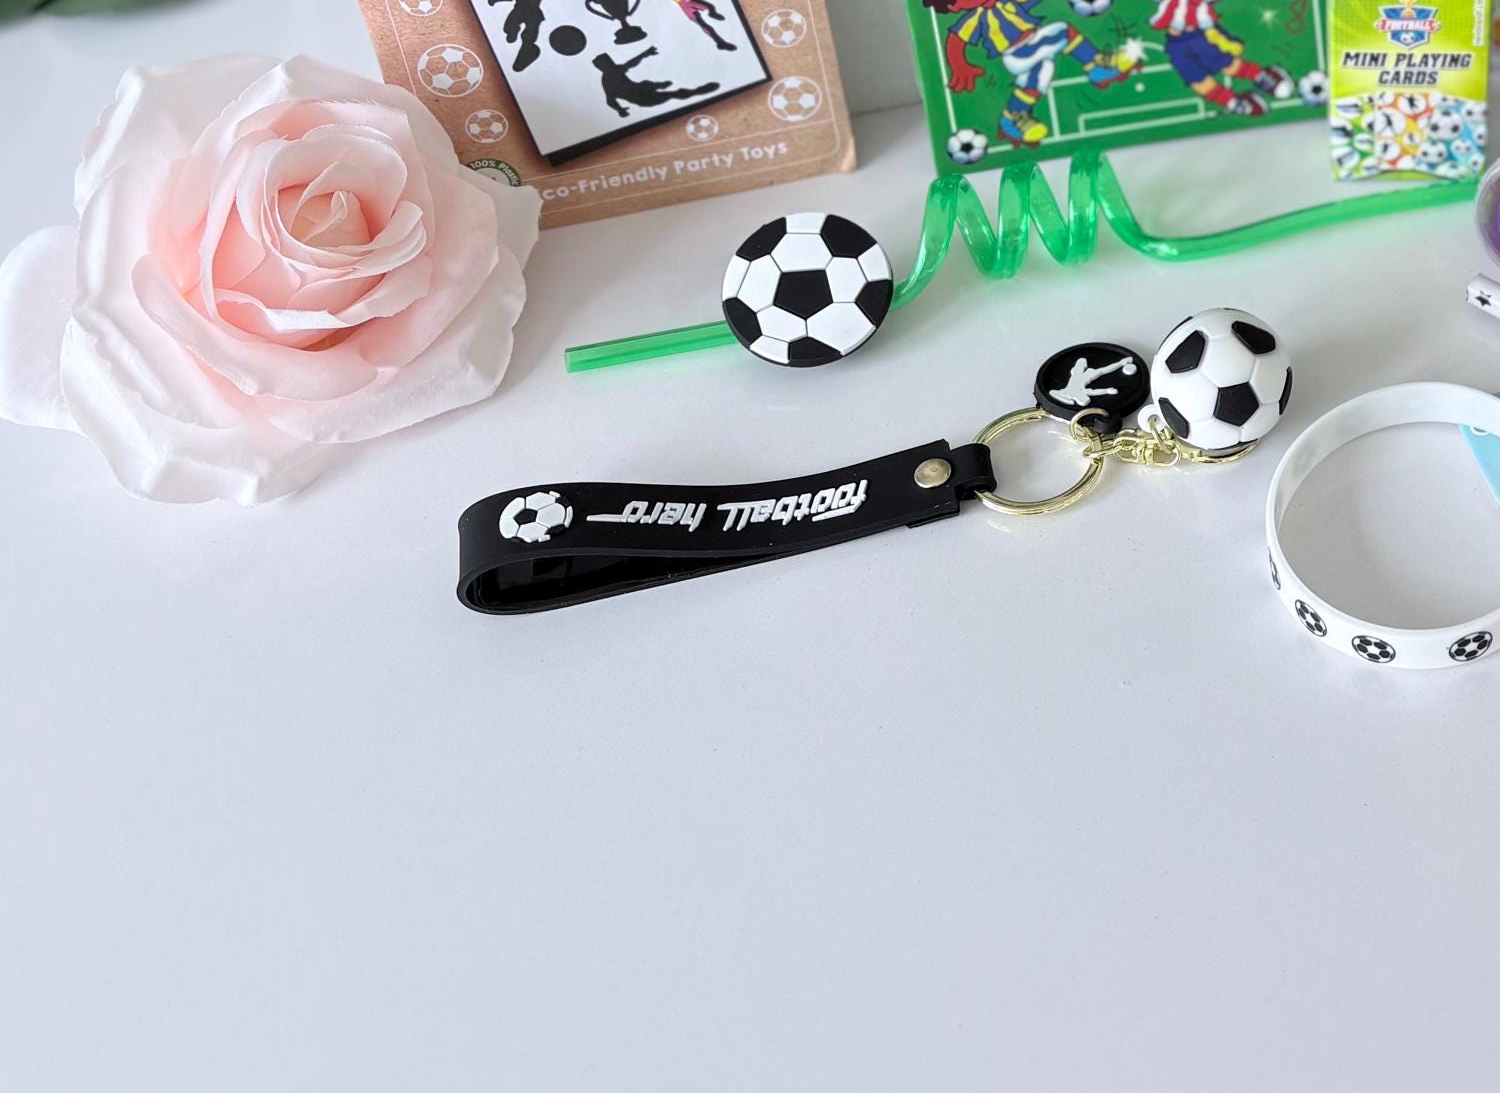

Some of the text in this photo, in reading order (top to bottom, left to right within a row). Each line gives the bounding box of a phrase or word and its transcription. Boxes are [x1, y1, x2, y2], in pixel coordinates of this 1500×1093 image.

[1343, 52, 1472, 68] MINI PLAYING
[1378, 70, 1438, 85] CARDS
[541, 140, 789, 203] co-Friendly Party Toys
[586, 479, 868, 532] football hero
